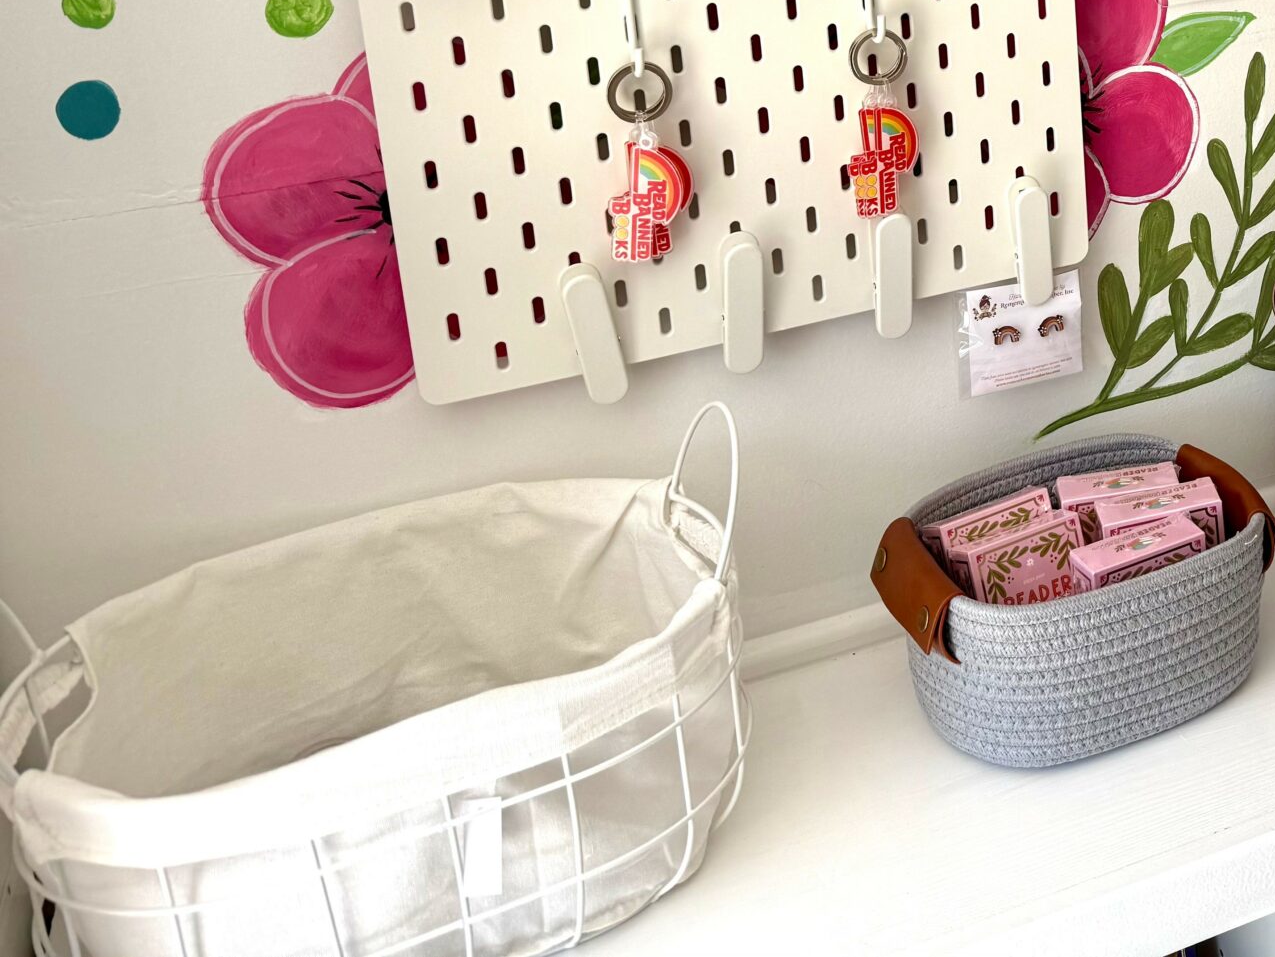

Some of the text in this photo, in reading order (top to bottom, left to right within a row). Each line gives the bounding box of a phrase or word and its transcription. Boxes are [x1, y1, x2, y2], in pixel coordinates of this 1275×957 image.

[877, 149, 897, 211] BANNED
[888, 131, 907, 172] READ
[647, 179, 668, 222] READ
[860, 159, 879, 216] BOOKS
[611, 199, 632, 260] BOOKS
[633, 193, 652, 261] BANNED
